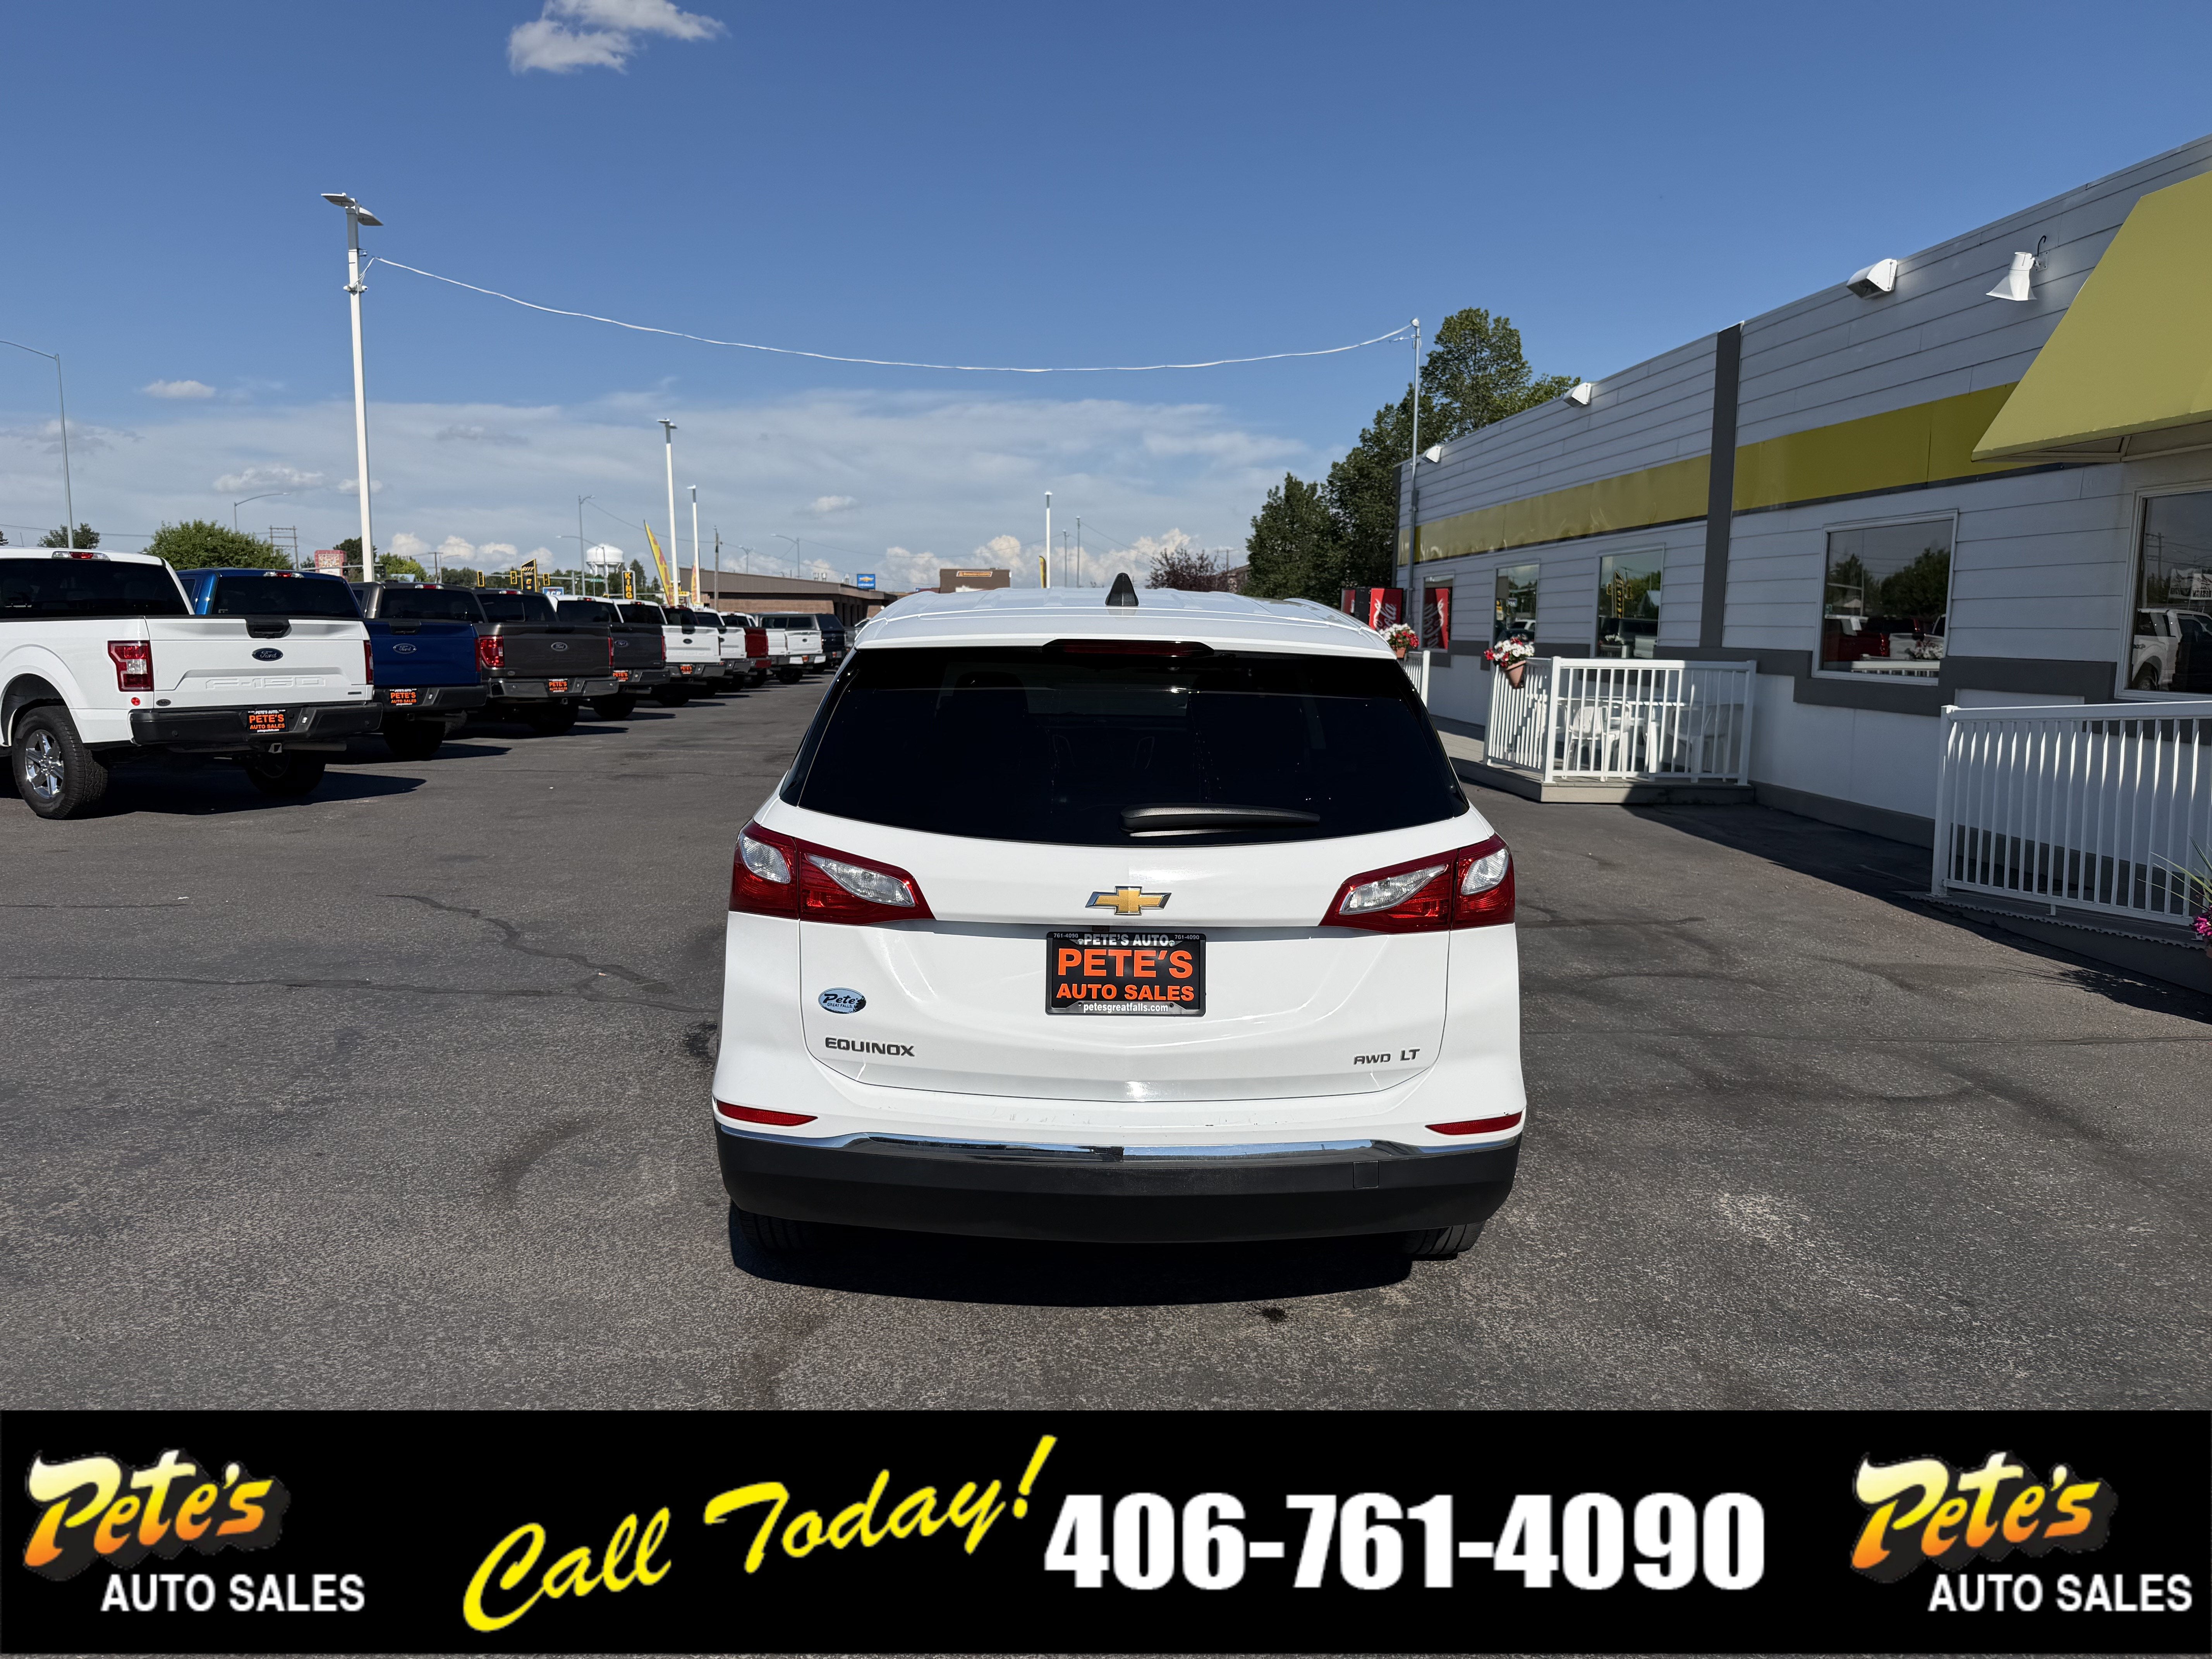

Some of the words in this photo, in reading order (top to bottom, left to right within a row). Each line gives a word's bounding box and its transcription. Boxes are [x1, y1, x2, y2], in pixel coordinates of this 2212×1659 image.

[249, 714, 284, 723] PETE'S
[1084, 933, 1129, 945] PETE'S
[1133, 934, 1169, 946] AUTO
[1058, 948, 1193, 979] PETE'S
[1056, 983, 1117, 999] AUTO
[1124, 984, 1194, 1001] SALES
[1084, 1002, 1168, 1013] petesgreatfalls.com
[825, 1037, 915, 1057] EQUINOX
[1353, 1053, 1391, 1065] AWD
[1400, 1049, 1420, 1061] LT
